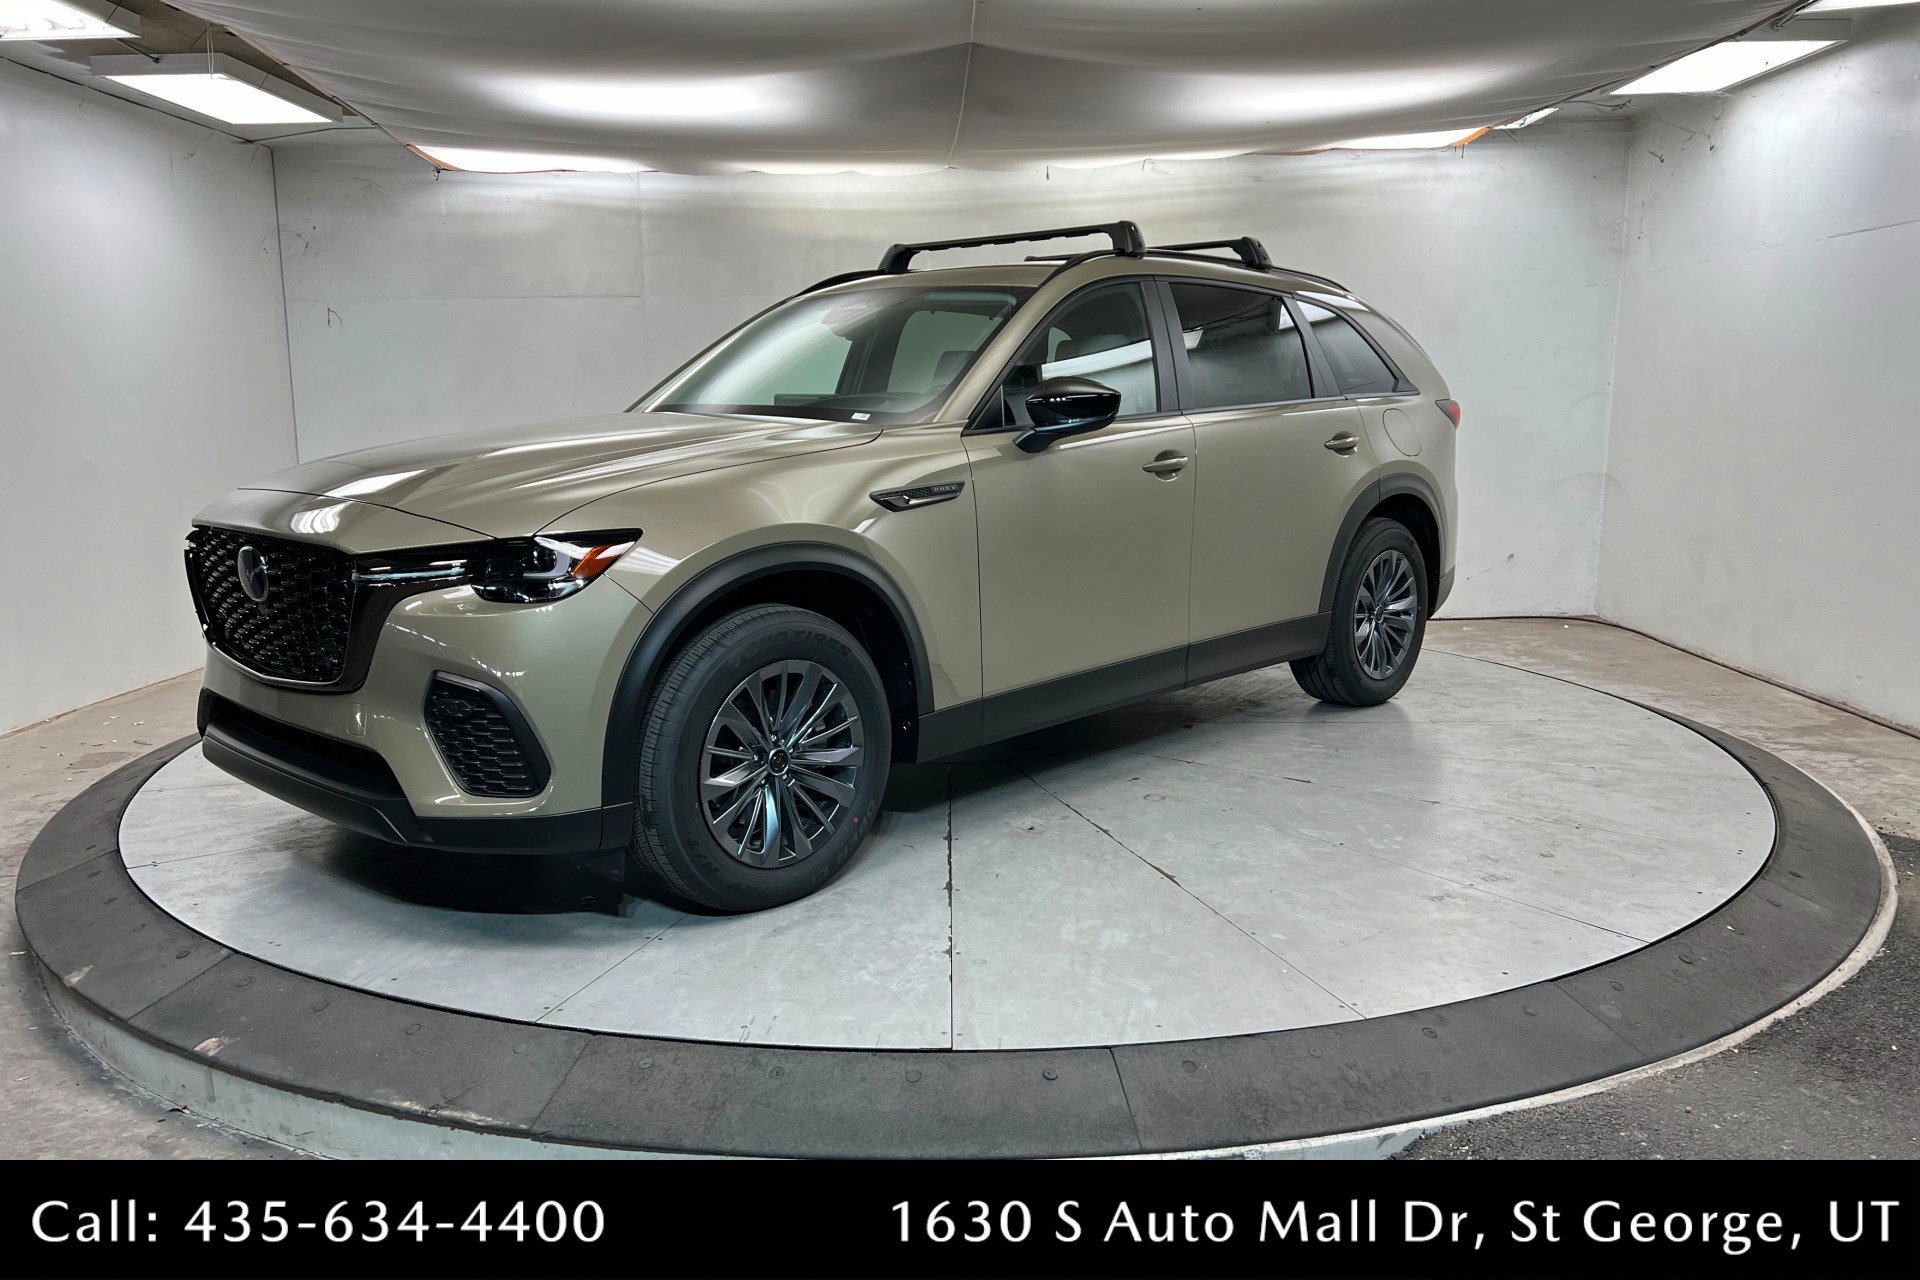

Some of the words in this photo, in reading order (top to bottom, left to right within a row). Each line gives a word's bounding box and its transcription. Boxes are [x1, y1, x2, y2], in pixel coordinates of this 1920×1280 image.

[934, 485, 957, 493] PHEV
[728, 630, 791, 669] TOYO
[791, 630, 852, 657] TIRES
